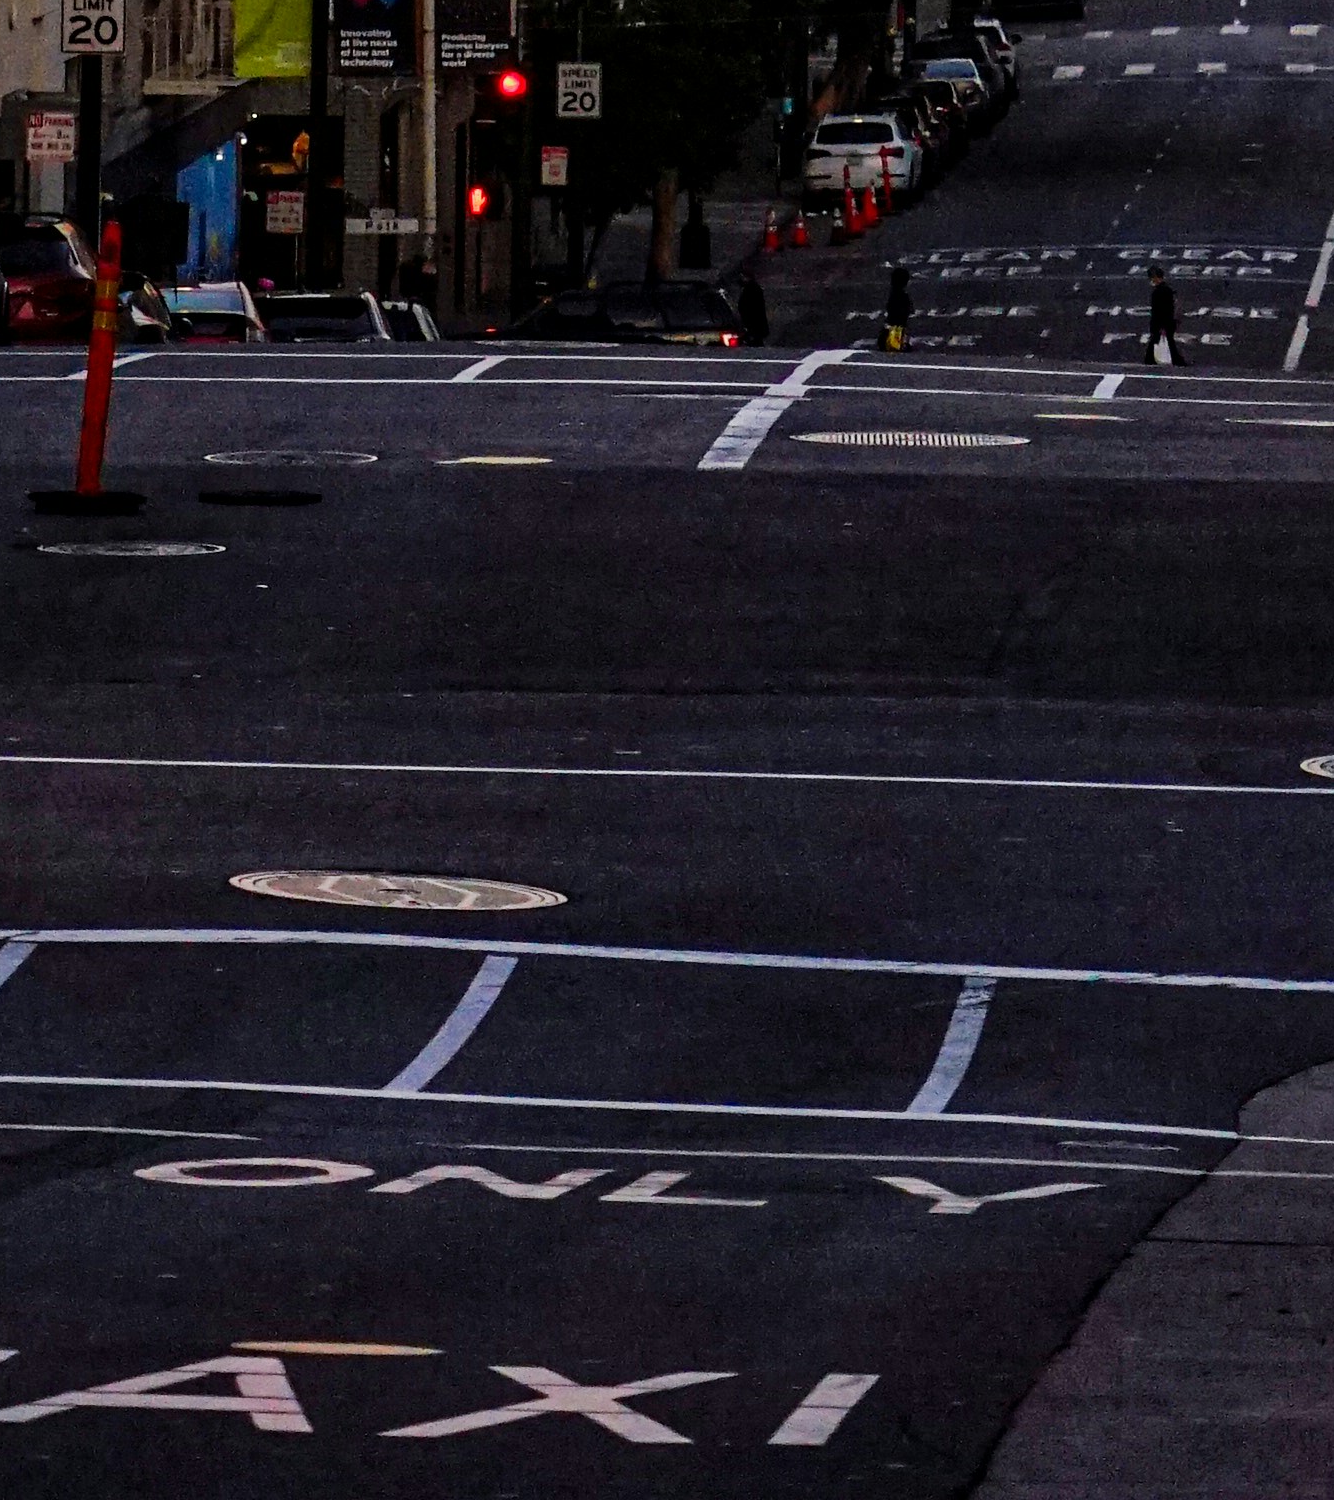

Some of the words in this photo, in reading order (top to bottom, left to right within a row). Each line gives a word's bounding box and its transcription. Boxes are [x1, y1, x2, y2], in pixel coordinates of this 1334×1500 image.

[68, 15, 119, 45] 20
[561, 69, 598, 78] SPEED
[564, 80, 592, 89] LIMIT
[562, 91, 596, 112] 20
[898, 251, 1077, 264] CLEAR
[1118, 249, 1299, 263] CLEAR
[851, 335, 983, 348] FRE
[132, 1157, 1105, 1215] ONLY
